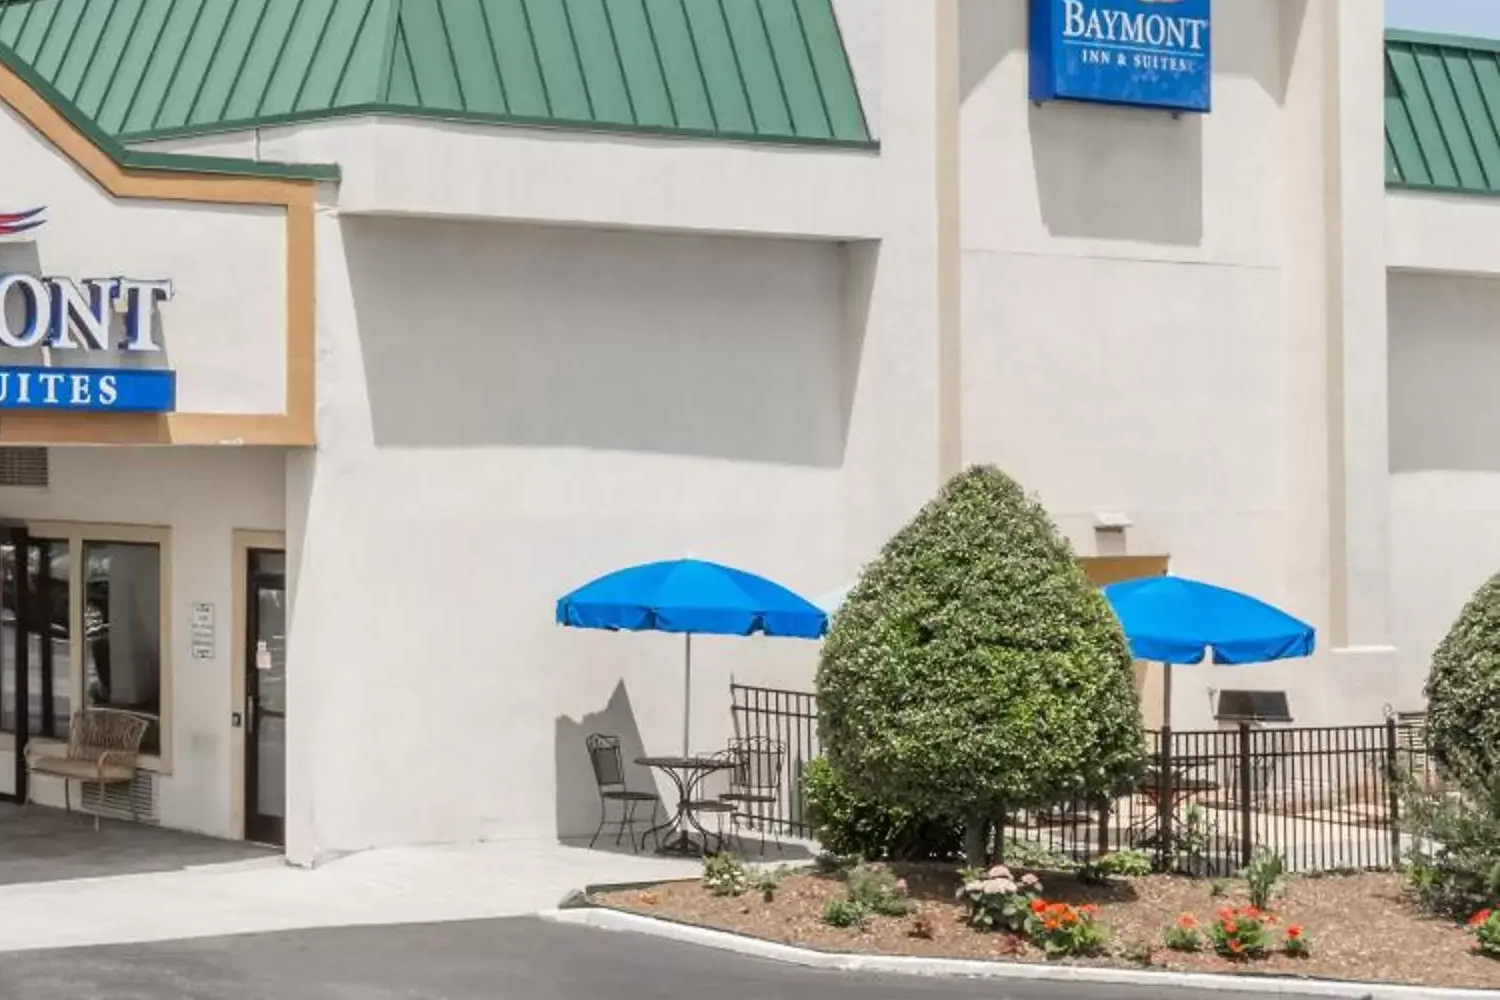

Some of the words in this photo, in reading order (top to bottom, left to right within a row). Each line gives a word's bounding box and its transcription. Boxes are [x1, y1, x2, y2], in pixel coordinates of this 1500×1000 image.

[1082, 48, 1111, 65] INN
[1117, 52, 1127, 67] &
[1133, 54, 1188, 71] SUITES
